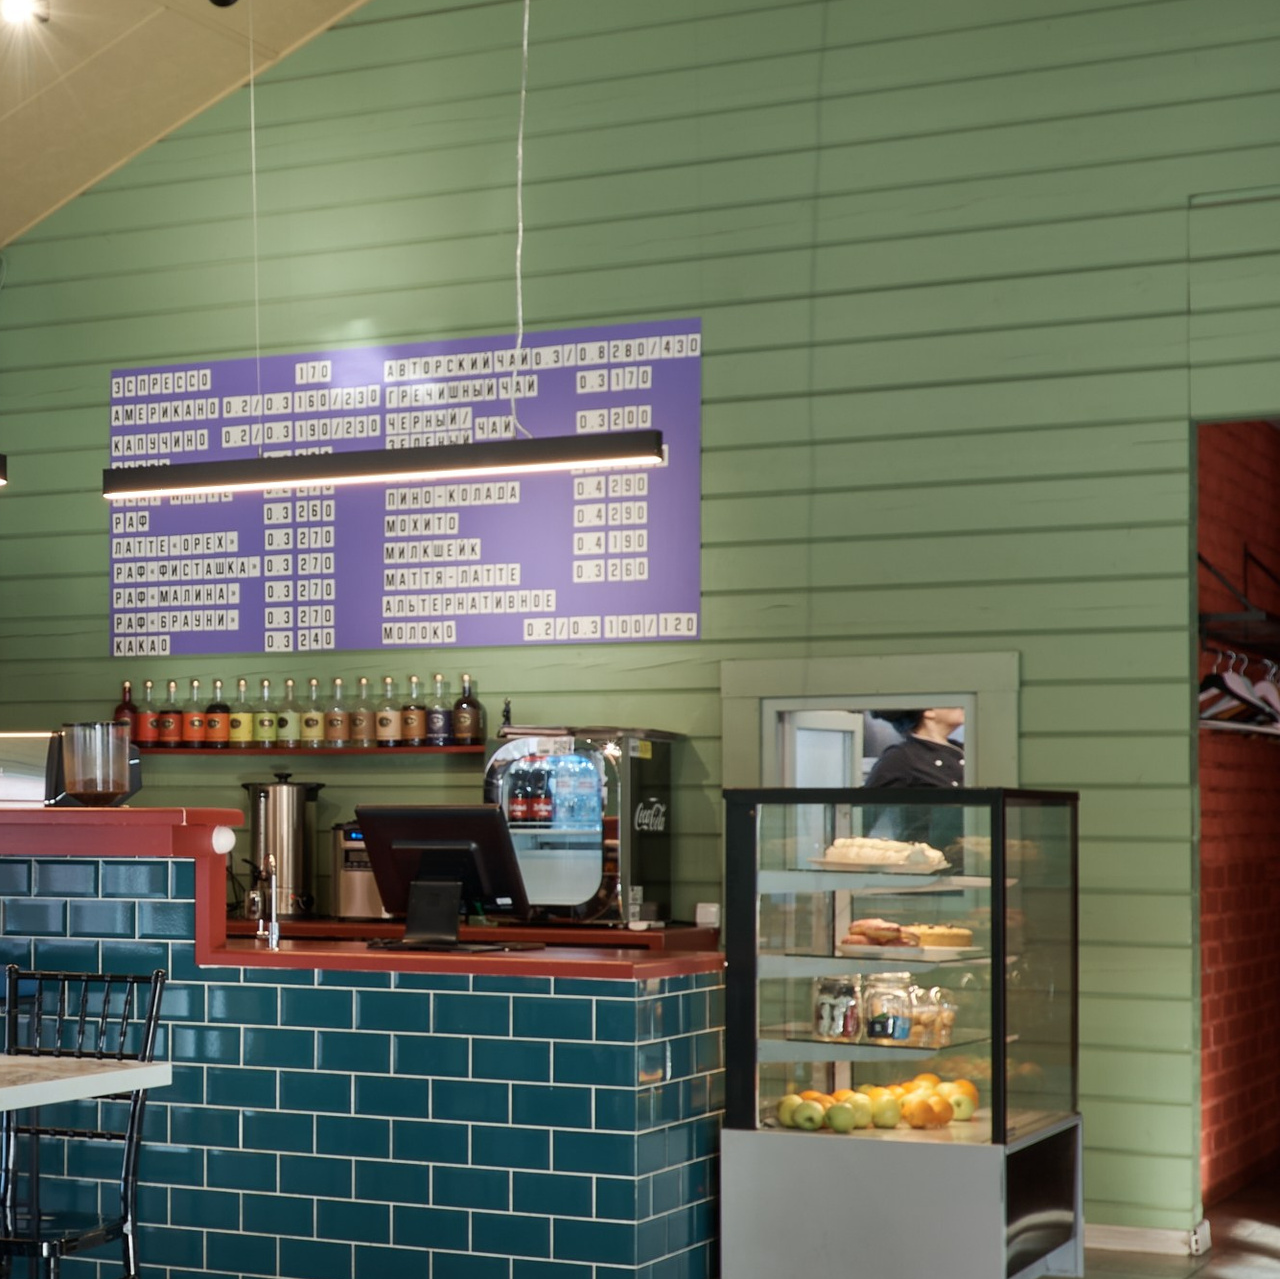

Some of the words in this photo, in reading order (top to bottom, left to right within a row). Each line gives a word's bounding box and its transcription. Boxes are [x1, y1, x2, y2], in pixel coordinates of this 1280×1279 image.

[387, 352, 490, 378] АВТОРСКИЙ
[496, 347, 529, 367] ЧАЙ
[612, 337, 698, 359] 280/430
[298, 363, 328, 381] 170
[388, 378, 495, 406] ГРЕЧИШНЫЙ
[501, 375, 535, 395] ЧАЙ
[615, 368, 649, 386] 170
[114, 401, 217, 423] АМЕРИКАНО
[297, 388, 378, 410] 160/230
[478, 415, 512, 435] ЧАЙ
[614, 409, 649, 427] 200
[114, 434, 206, 454] КАПУЧИНО
[298, 418, 379, 439] 190/230
[387, 485, 518, 506] ПИНО-КОЛАДА
[611, 477, 646, 494] 290
[115, 514, 148, 532] РАФ
[266, 504, 290, 521] 0.3
[298, 504, 333, 521] 260
[386, 516, 458, 535] МОХИТО
[611, 505, 645, 523] 290
[267, 531, 291, 548] 0.3
[299, 530, 332, 547] 270
[385, 538, 479, 561] МИЛКШЕЙК
[612, 533, 645, 551] 190
[266, 557, 290, 574] 0.3
[300, 556, 332, 573] 270
[385, 567, 518, 588] МАТТЯ-ЛАТТЕ
[611, 561, 645, 578] 260
[267, 583, 291, 600] 0.3
[299, 582, 333, 599] 270
[384, 592, 554, 614] АЛЬТЕРНАТИВНОЕ
[267, 609, 291, 626] 0.3
[300, 608, 333, 625] 270
[383, 622, 454, 641] МОЛОКО
[608, 616, 696, 635] 100/120
[115, 637, 169, 654] КАКАО
[267, 633, 291, 650] 0.3
[300, 632, 333, 649] 240
